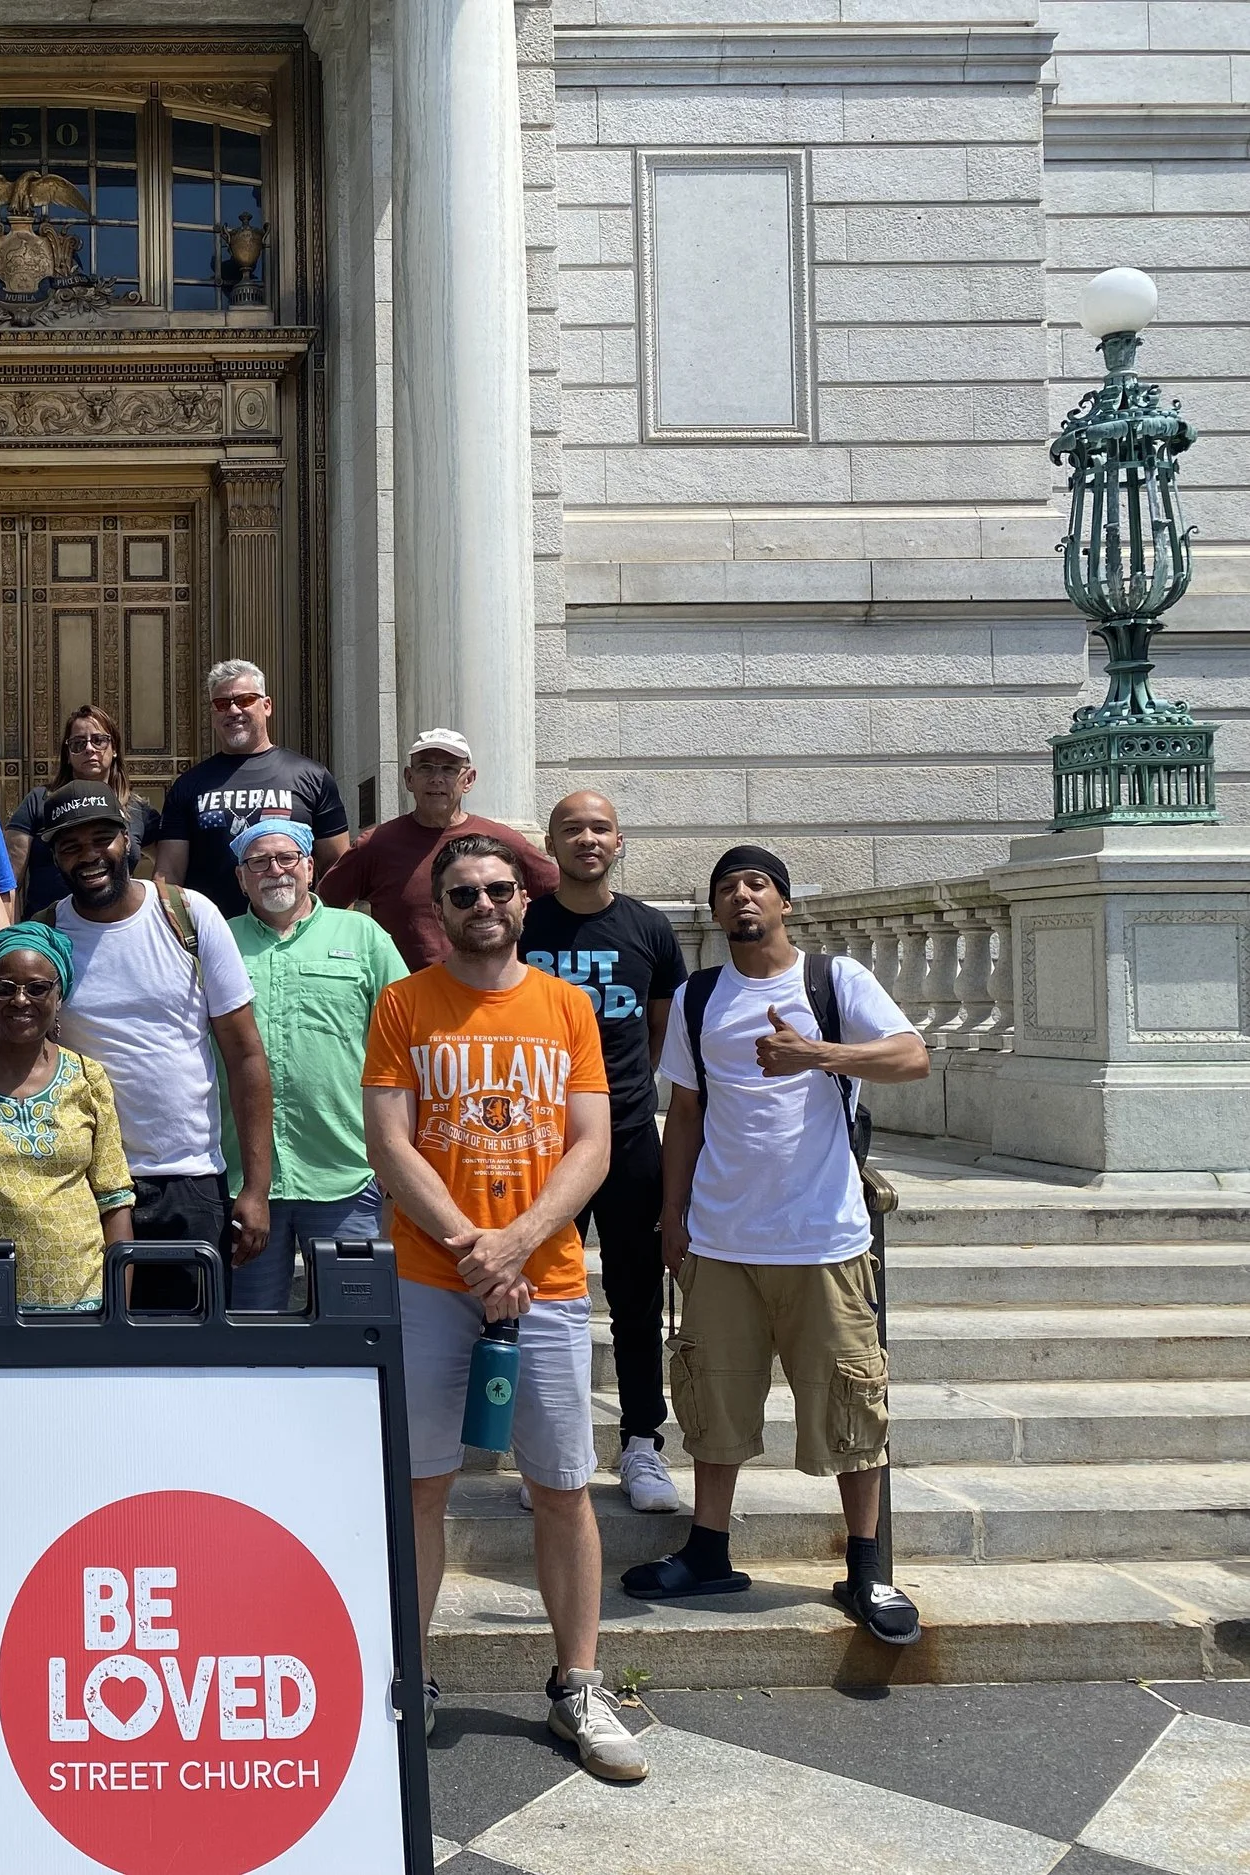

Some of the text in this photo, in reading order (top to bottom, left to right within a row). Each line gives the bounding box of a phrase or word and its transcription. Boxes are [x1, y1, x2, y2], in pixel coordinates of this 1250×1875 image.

[5, 292, 37, 302] NUBILA
[197, 789, 293, 813] VETERAN
[526, 950, 619, 985] BUT
[516, 1036, 549, 1045] COUNTRY
[432, 1103, 451, 1112] EST.
[437, 1121, 469, 1144] KINGDOM
[470, 1136, 481, 1147] OF
[483, 1137, 498, 1151] THE
[83, 1566, 180, 1650] BE
[48, 1654, 317, 1742] LOVED
[49, 1759, 321, 1791] STREET CHURCH
